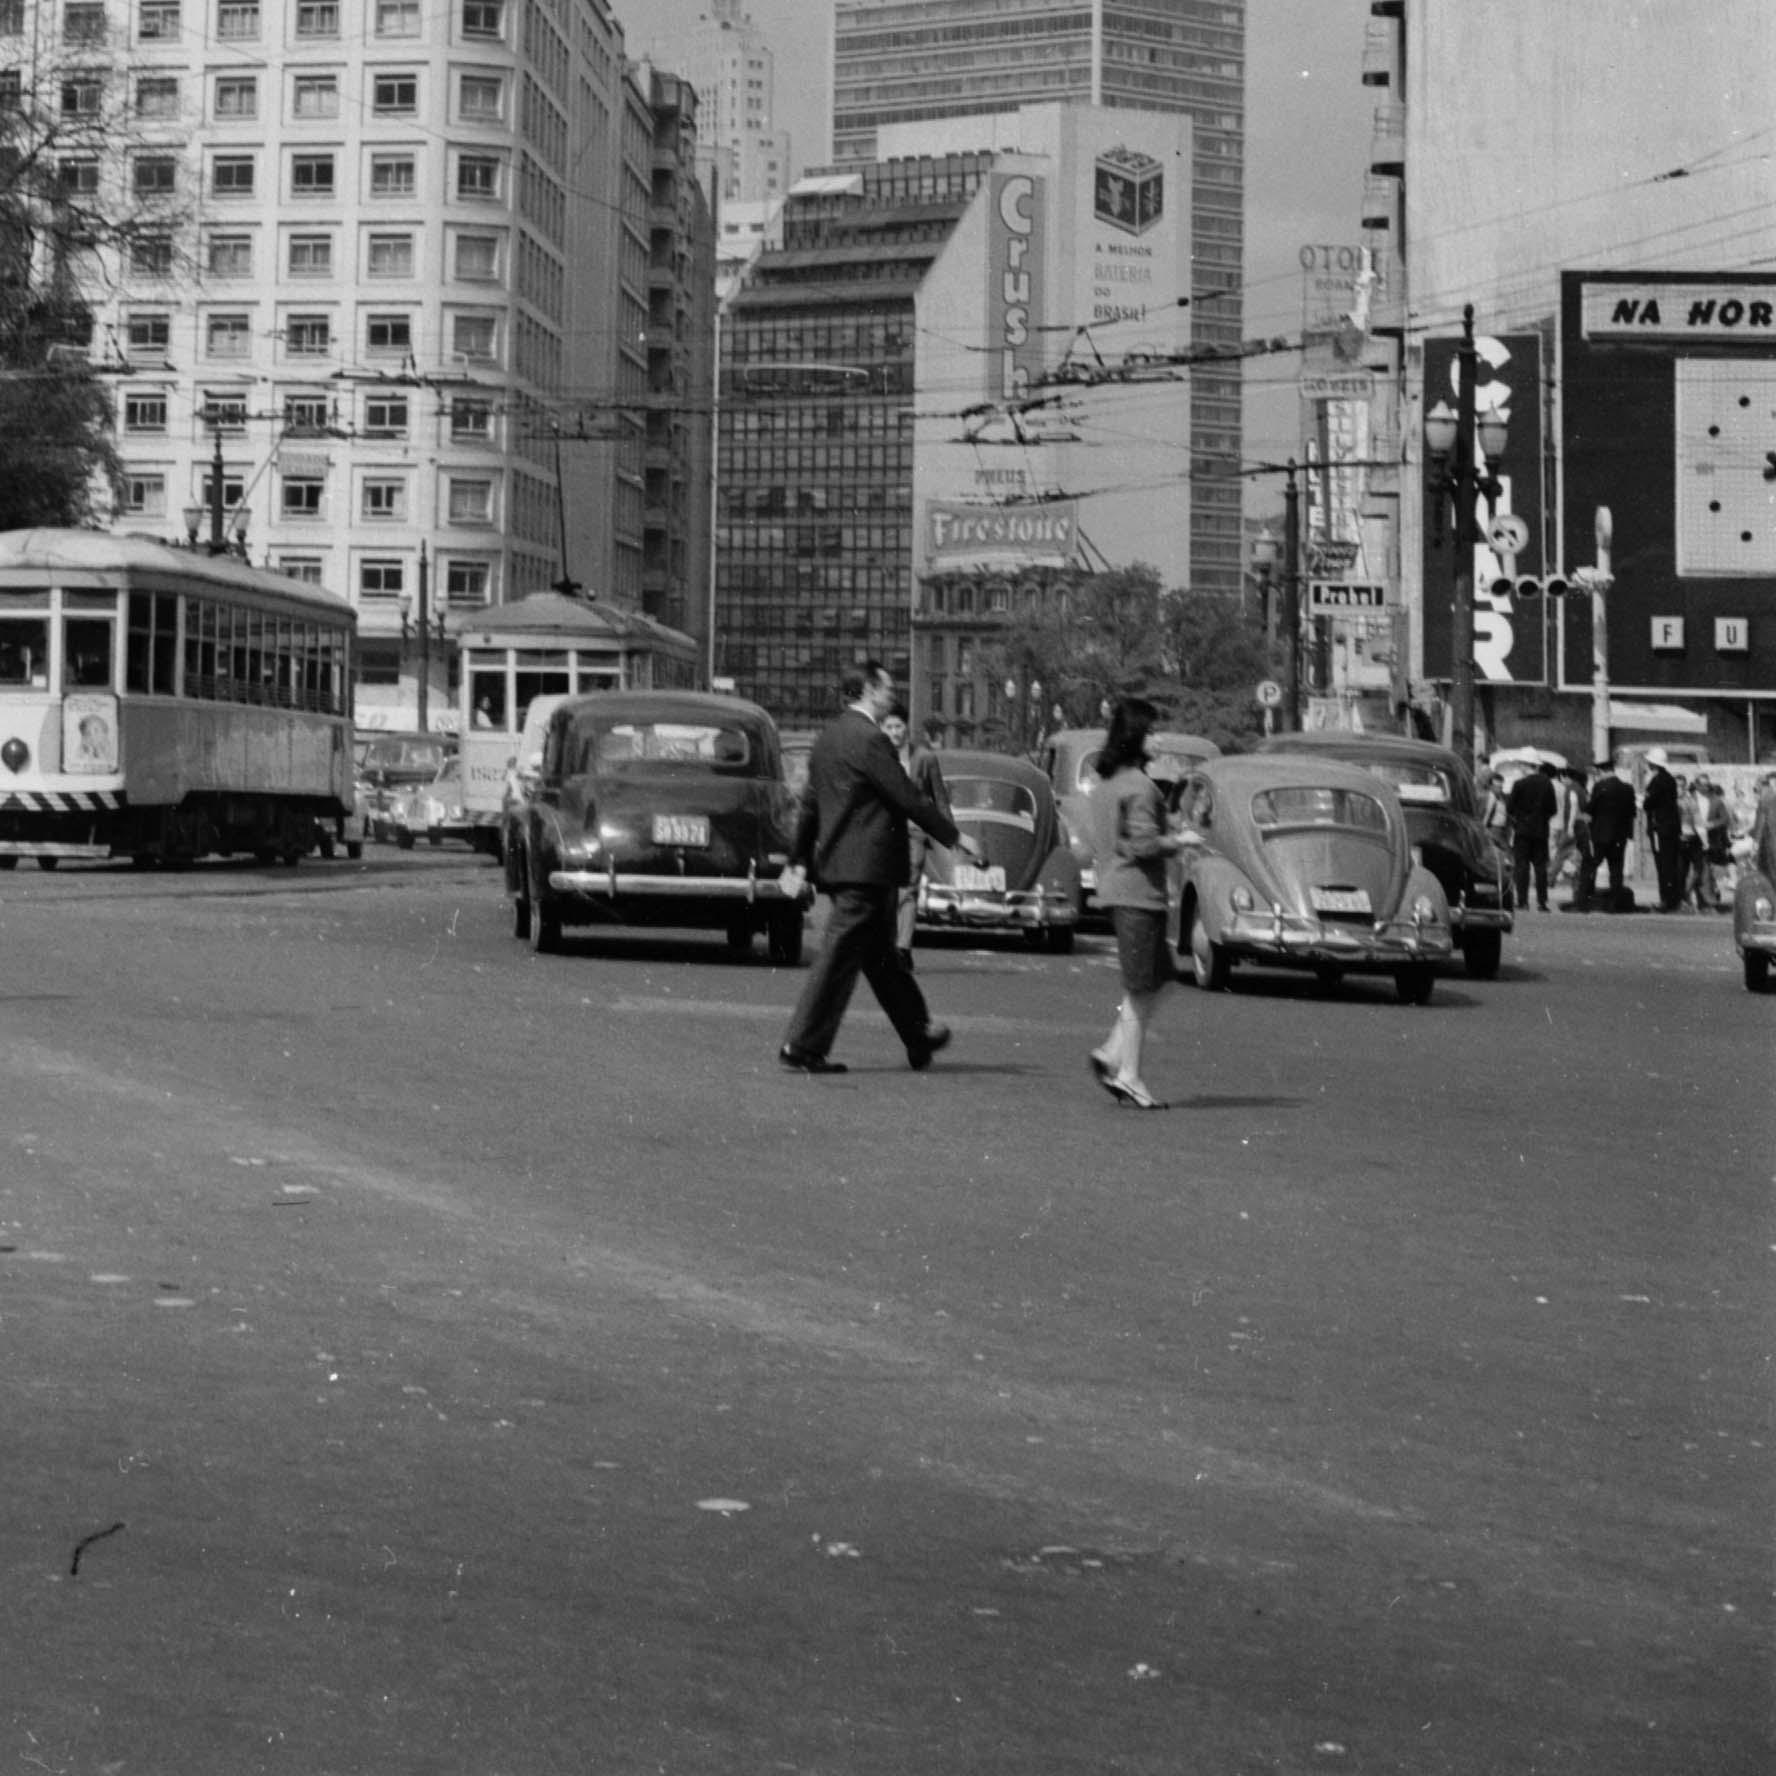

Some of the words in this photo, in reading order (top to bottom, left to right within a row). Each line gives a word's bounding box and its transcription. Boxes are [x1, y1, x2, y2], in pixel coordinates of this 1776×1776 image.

[1108, 243, 1153, 257] MELHOR
[1094, 263, 1152, 282] BATERIA
[999, 175, 1035, 402] Crush
[1094, 286, 1111, 298] DO
[1611, 298, 1661, 325] NA
[1687, 298, 1774, 327] HOR
[932, 512, 1070, 547] Firestone
[1663, 623, 1673, 644] F
[1725, 624, 1737, 645] U
[1264, 686, 1277, 702] P
